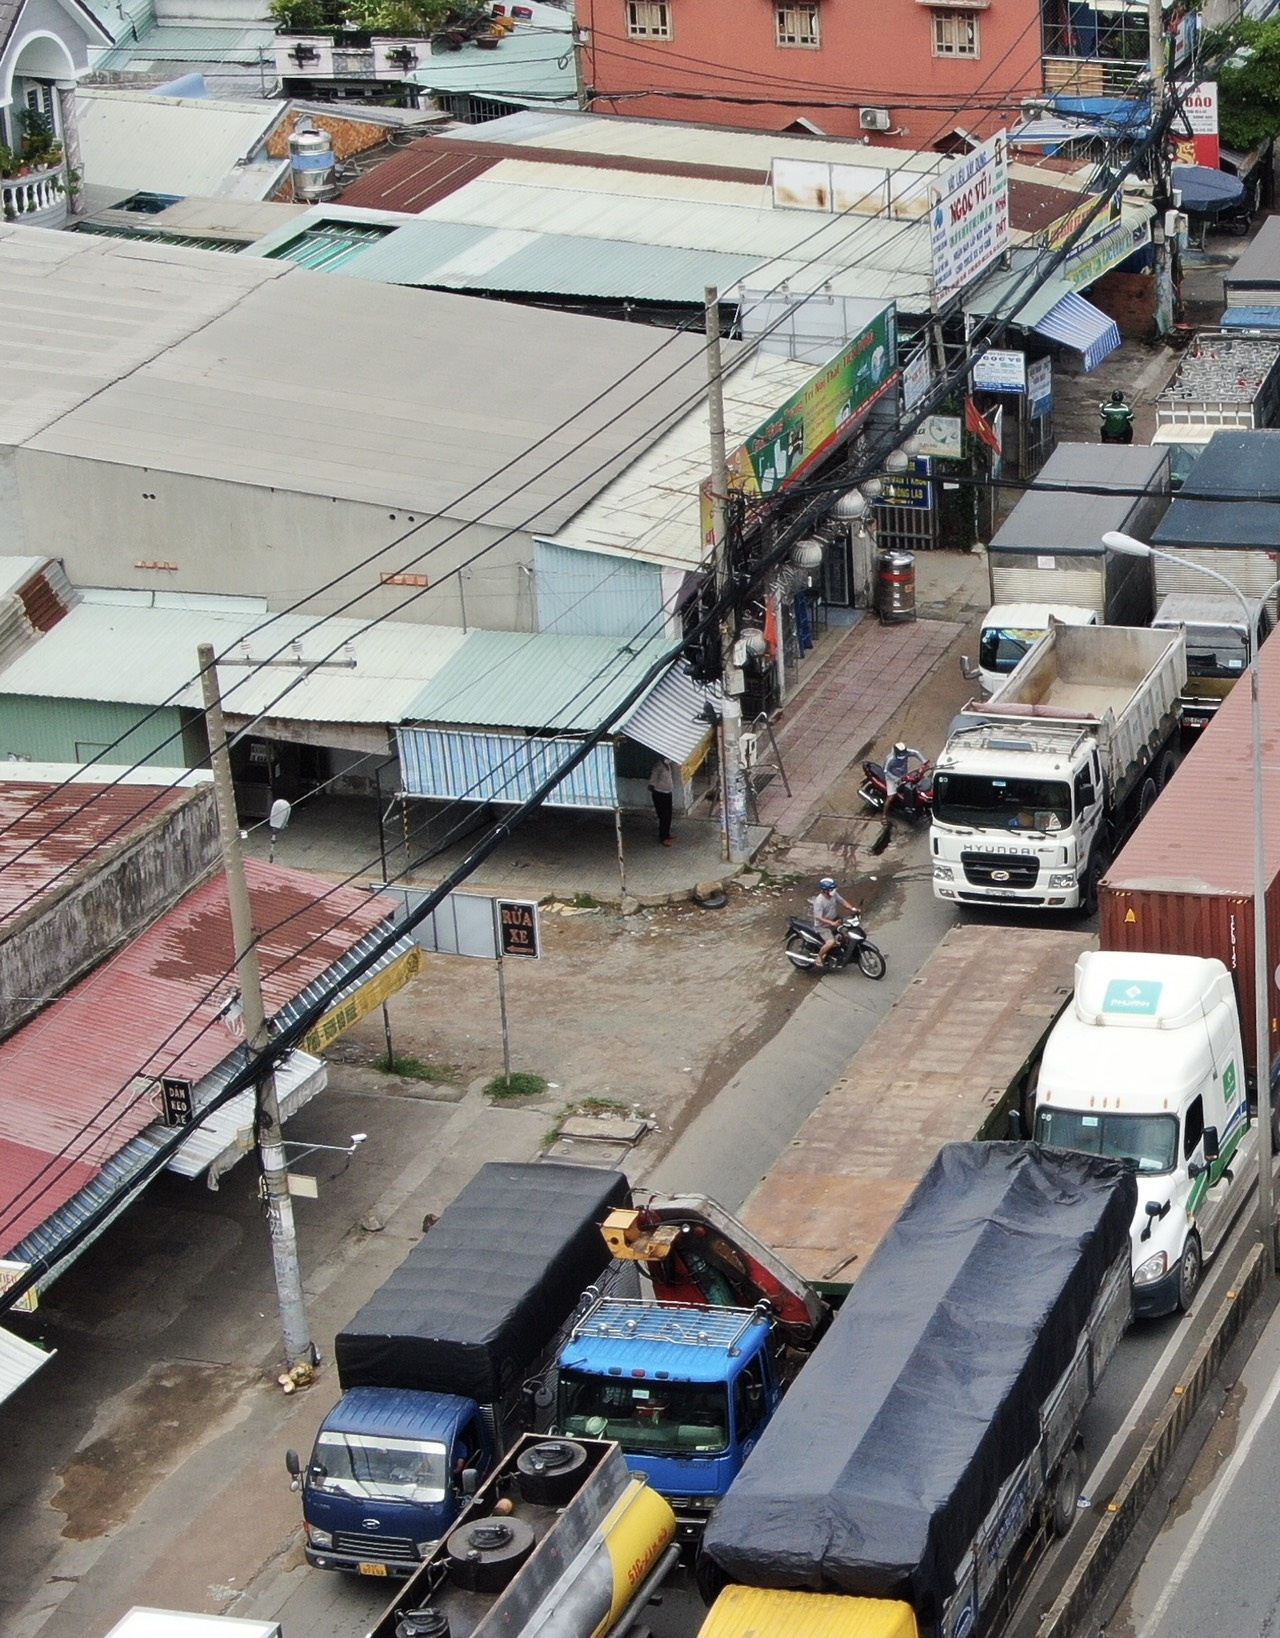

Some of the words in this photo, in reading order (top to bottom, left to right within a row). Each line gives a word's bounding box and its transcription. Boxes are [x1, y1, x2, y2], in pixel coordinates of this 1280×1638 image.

[950, 188, 974, 227] NGỌC
[964, 844, 1036, 855] HYUNDAI
[502, 906, 532, 926] RỬA
[510, 928, 529, 944] XE
[175, 1113, 187, 1125] XE
